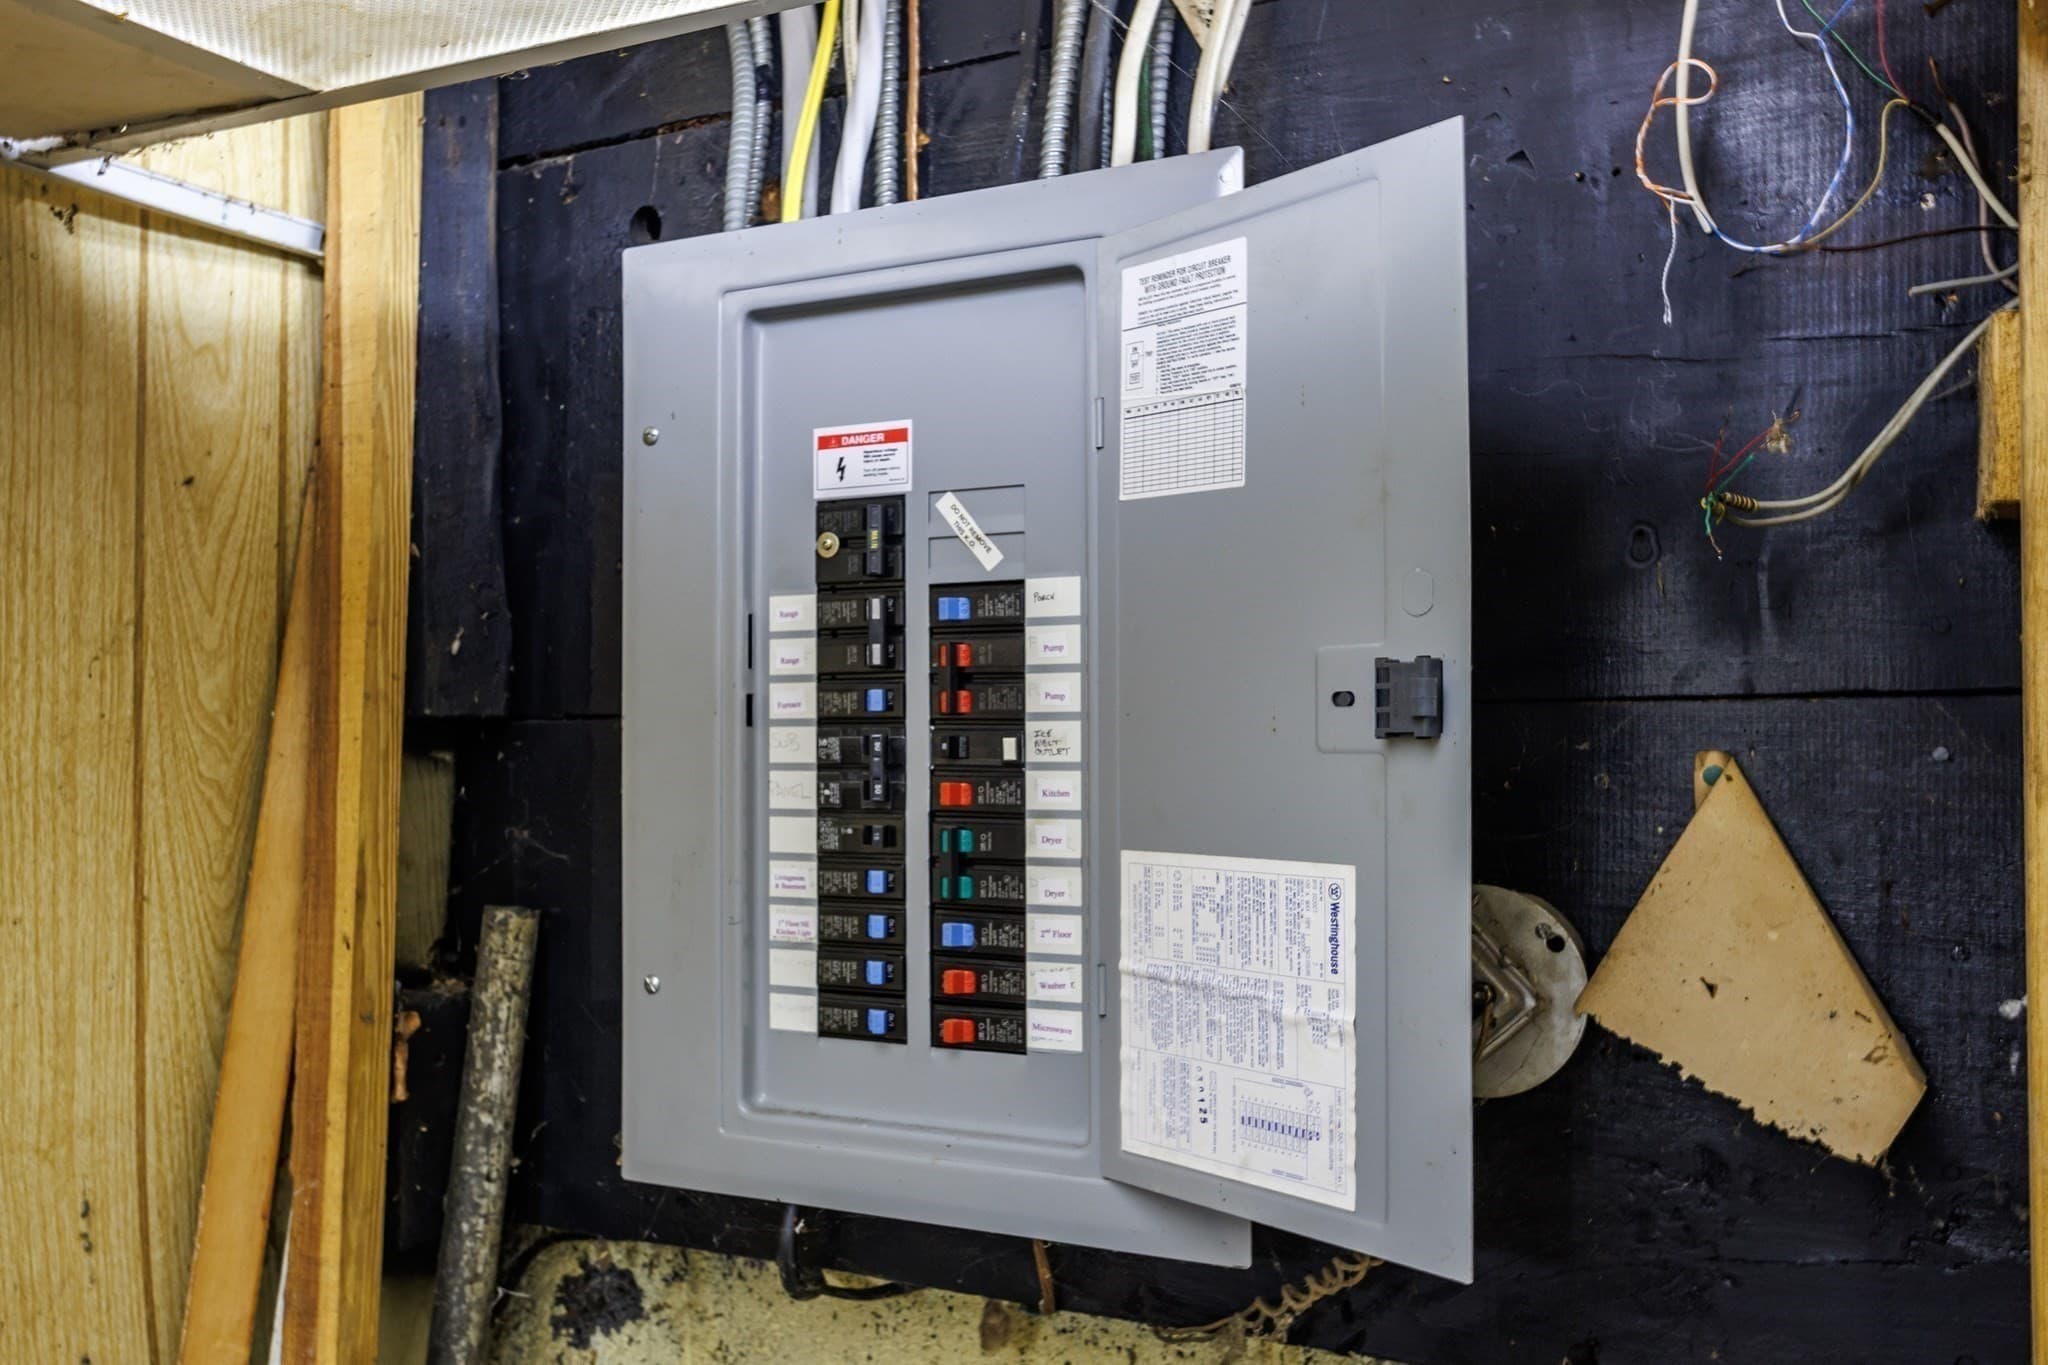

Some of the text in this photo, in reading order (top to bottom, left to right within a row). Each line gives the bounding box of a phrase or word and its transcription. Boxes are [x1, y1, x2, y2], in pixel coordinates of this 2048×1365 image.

[841, 433, 885, 445] DANGER
[950, 503, 992, 554] DO NOT REMOVE
[954, 520, 966, 536] THIS
[1043, 644, 1064, 654] Pump
[1044, 691, 1066, 702] Pump
[1042, 790, 1071, 798] Kitchen
[1041, 836, 1062, 846] Dryer
[1044, 890, 1065, 899] Dryer
[1052, 930, 1073, 938] Floor
[1328, 902, 1340, 974] Westinghouse
[1032, 1022, 1072, 1034] Microwave
